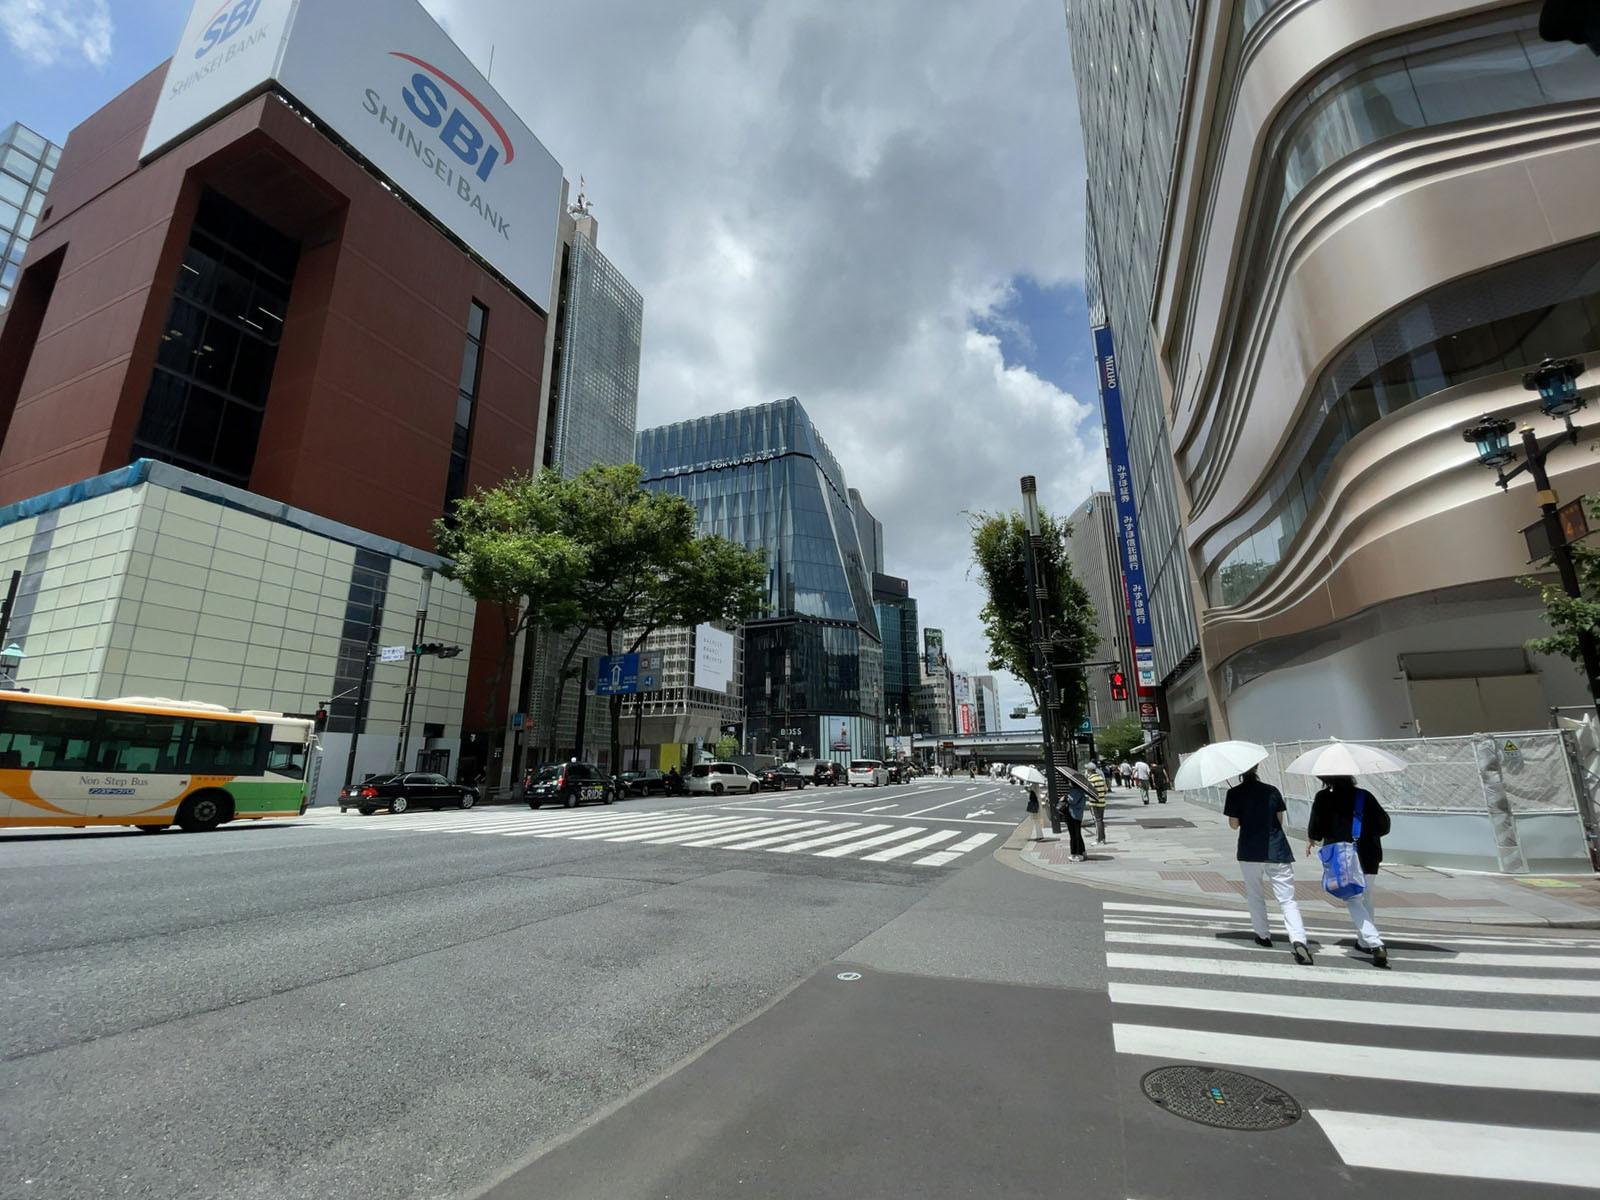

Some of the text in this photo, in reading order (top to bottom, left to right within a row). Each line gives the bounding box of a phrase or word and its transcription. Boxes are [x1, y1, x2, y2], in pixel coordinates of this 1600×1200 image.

[195, 0, 262, 59] SBI
[169, 23, 272, 100] SHINSEI BANK
[402, 73, 499, 183] SBI
[362, 88, 511, 240] SHINSEI BANK
[1105, 355, 1117, 389] MIZUHO
[710, 454, 774, 470] TOKYU PLAZA
[1117, 465, 1130, 503] みずほ証券
[1123, 516, 1139, 571] みずほ信託銀行
[1132, 584, 1146, 624] みずほ銀行
[79, 776, 149, 787] Non Step Bus
